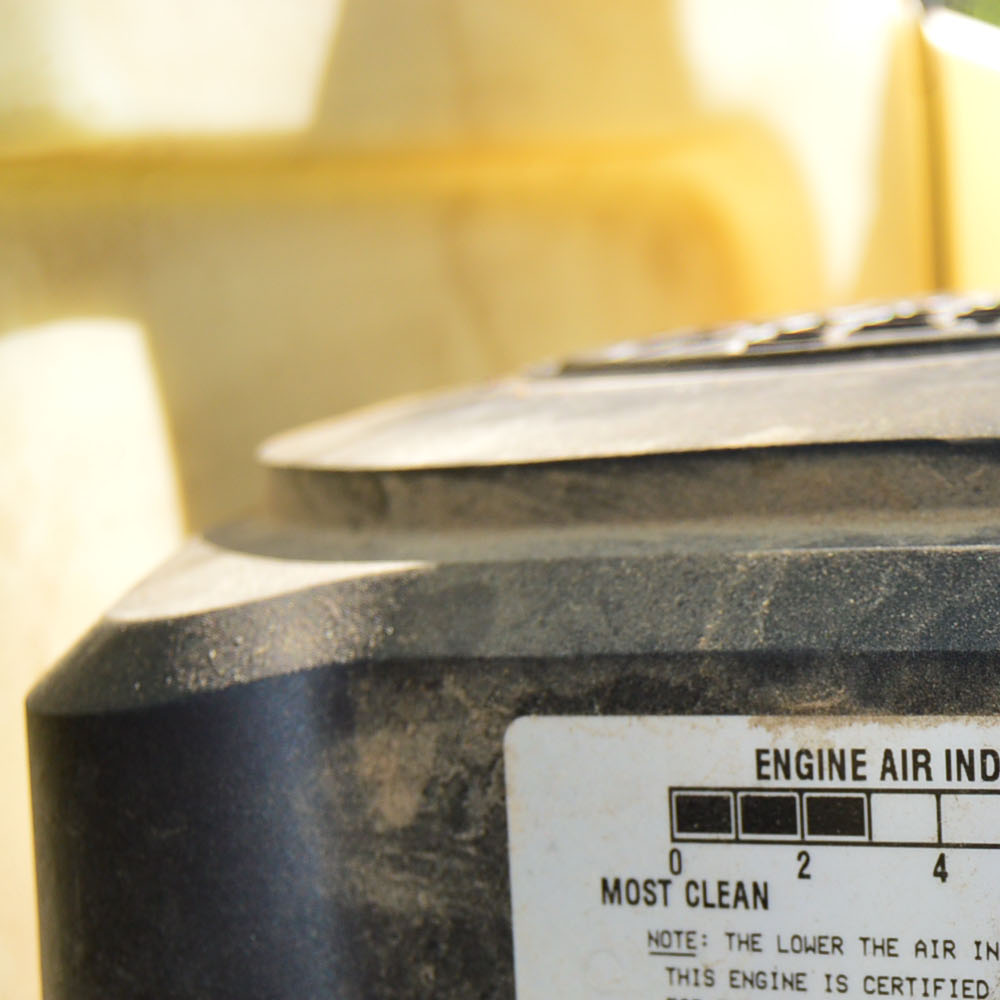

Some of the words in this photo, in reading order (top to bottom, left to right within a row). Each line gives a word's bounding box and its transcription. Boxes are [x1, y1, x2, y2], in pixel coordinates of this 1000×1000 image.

[755, 747, 868, 782] ENGINE
[879, 748, 934, 782] AIR
[668, 847, 683, 876] 0
[796, 850, 812, 880] 2
[932, 852, 949, 884] 4
[600, 877, 673, 907] MOST
[684, 879, 769, 911] CLEAN
[647, 931, 708, 950] NOTE:
[725, 932, 763, 953] THE
[777, 934, 844, 955] LOWER
[858, 936, 899, 958] THE
[914, 939, 956, 960] AIR
[666, 966, 715, 988] THIS
[729, 969, 807, 992] ENGINE
[824, 973, 849, 994] IS
[863, 975, 990, 1000] CERTIFIED
